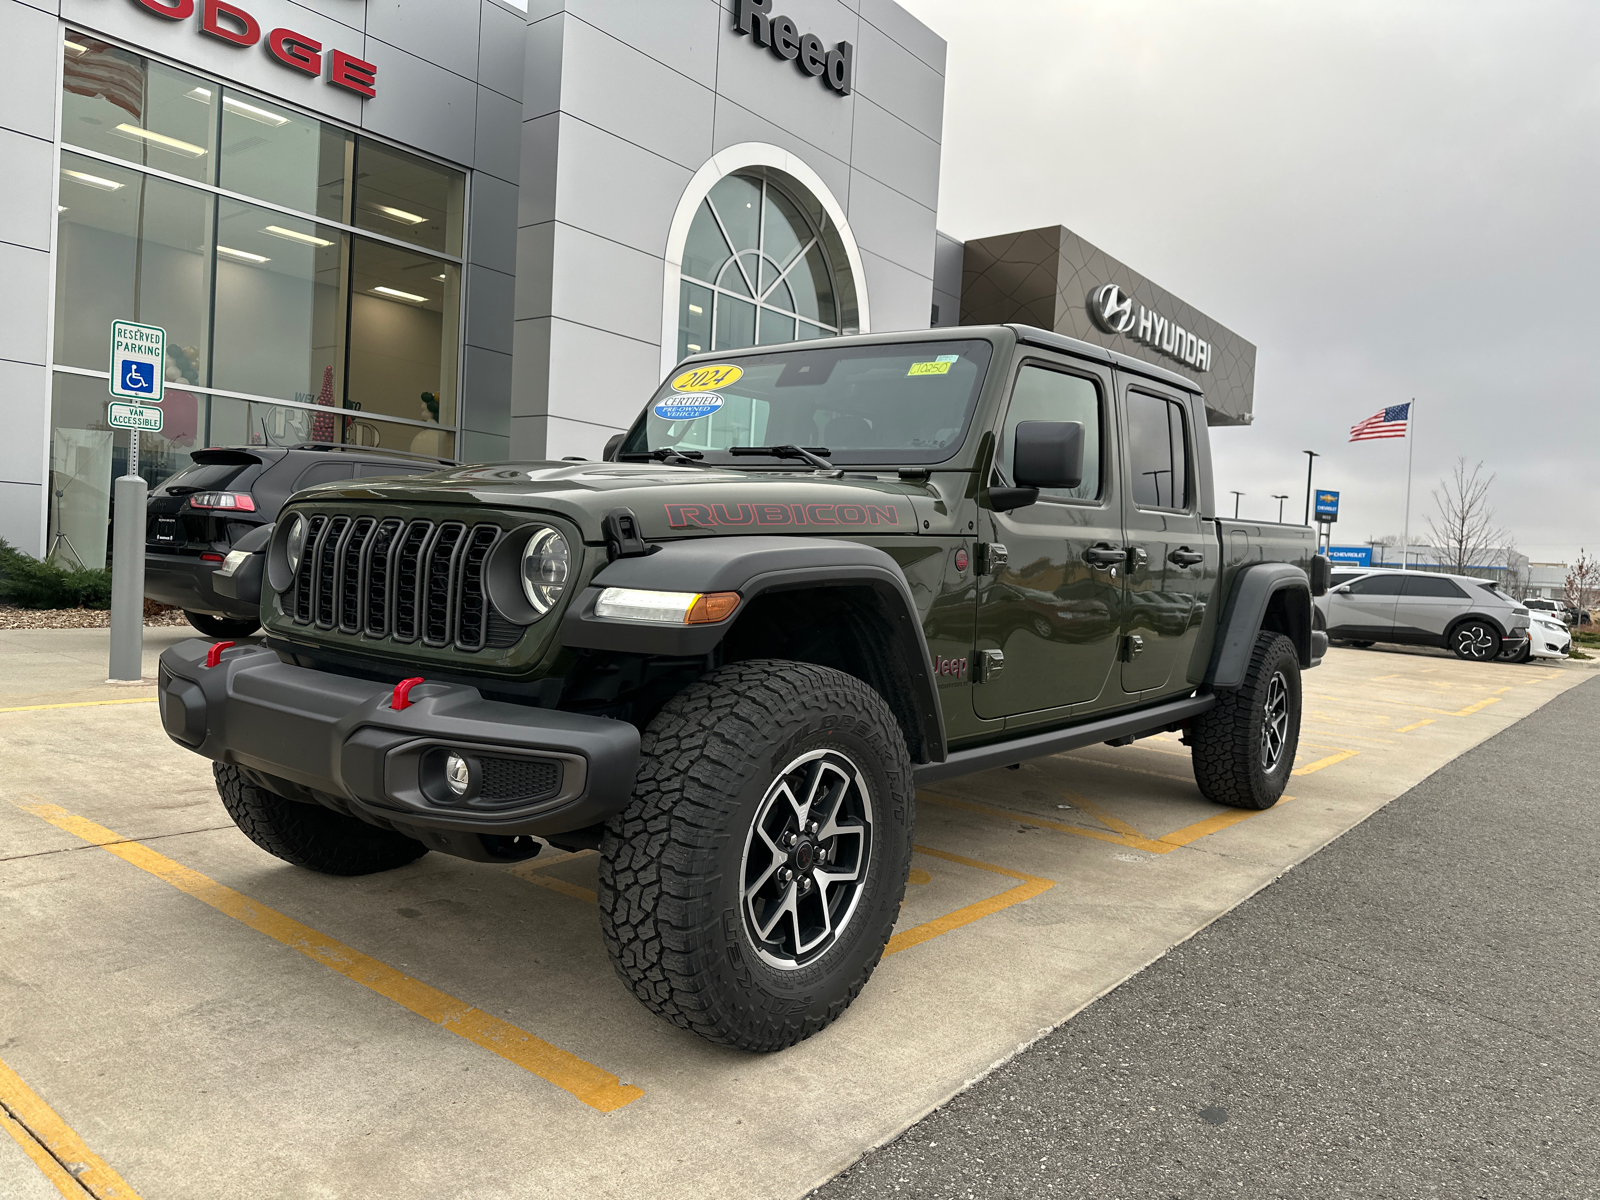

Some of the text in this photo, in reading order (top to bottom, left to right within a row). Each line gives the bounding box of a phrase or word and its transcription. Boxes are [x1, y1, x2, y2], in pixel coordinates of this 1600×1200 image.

[733, 0, 853, 96] Reed
[117, 327, 160, 344] RESERVED
[1137, 304, 1212, 372] HYUNDAI
[116, 340, 160, 357] PARKING
[677, 367, 734, 389] 2024
[664, 396, 719, 406] CERTIFIED
[113, 415, 159, 427] ACCESSIBLE
[129, 408, 144, 417] VAN
[664, 503, 900, 526] RUBICON
[932, 655, 966, 679] Jeep
